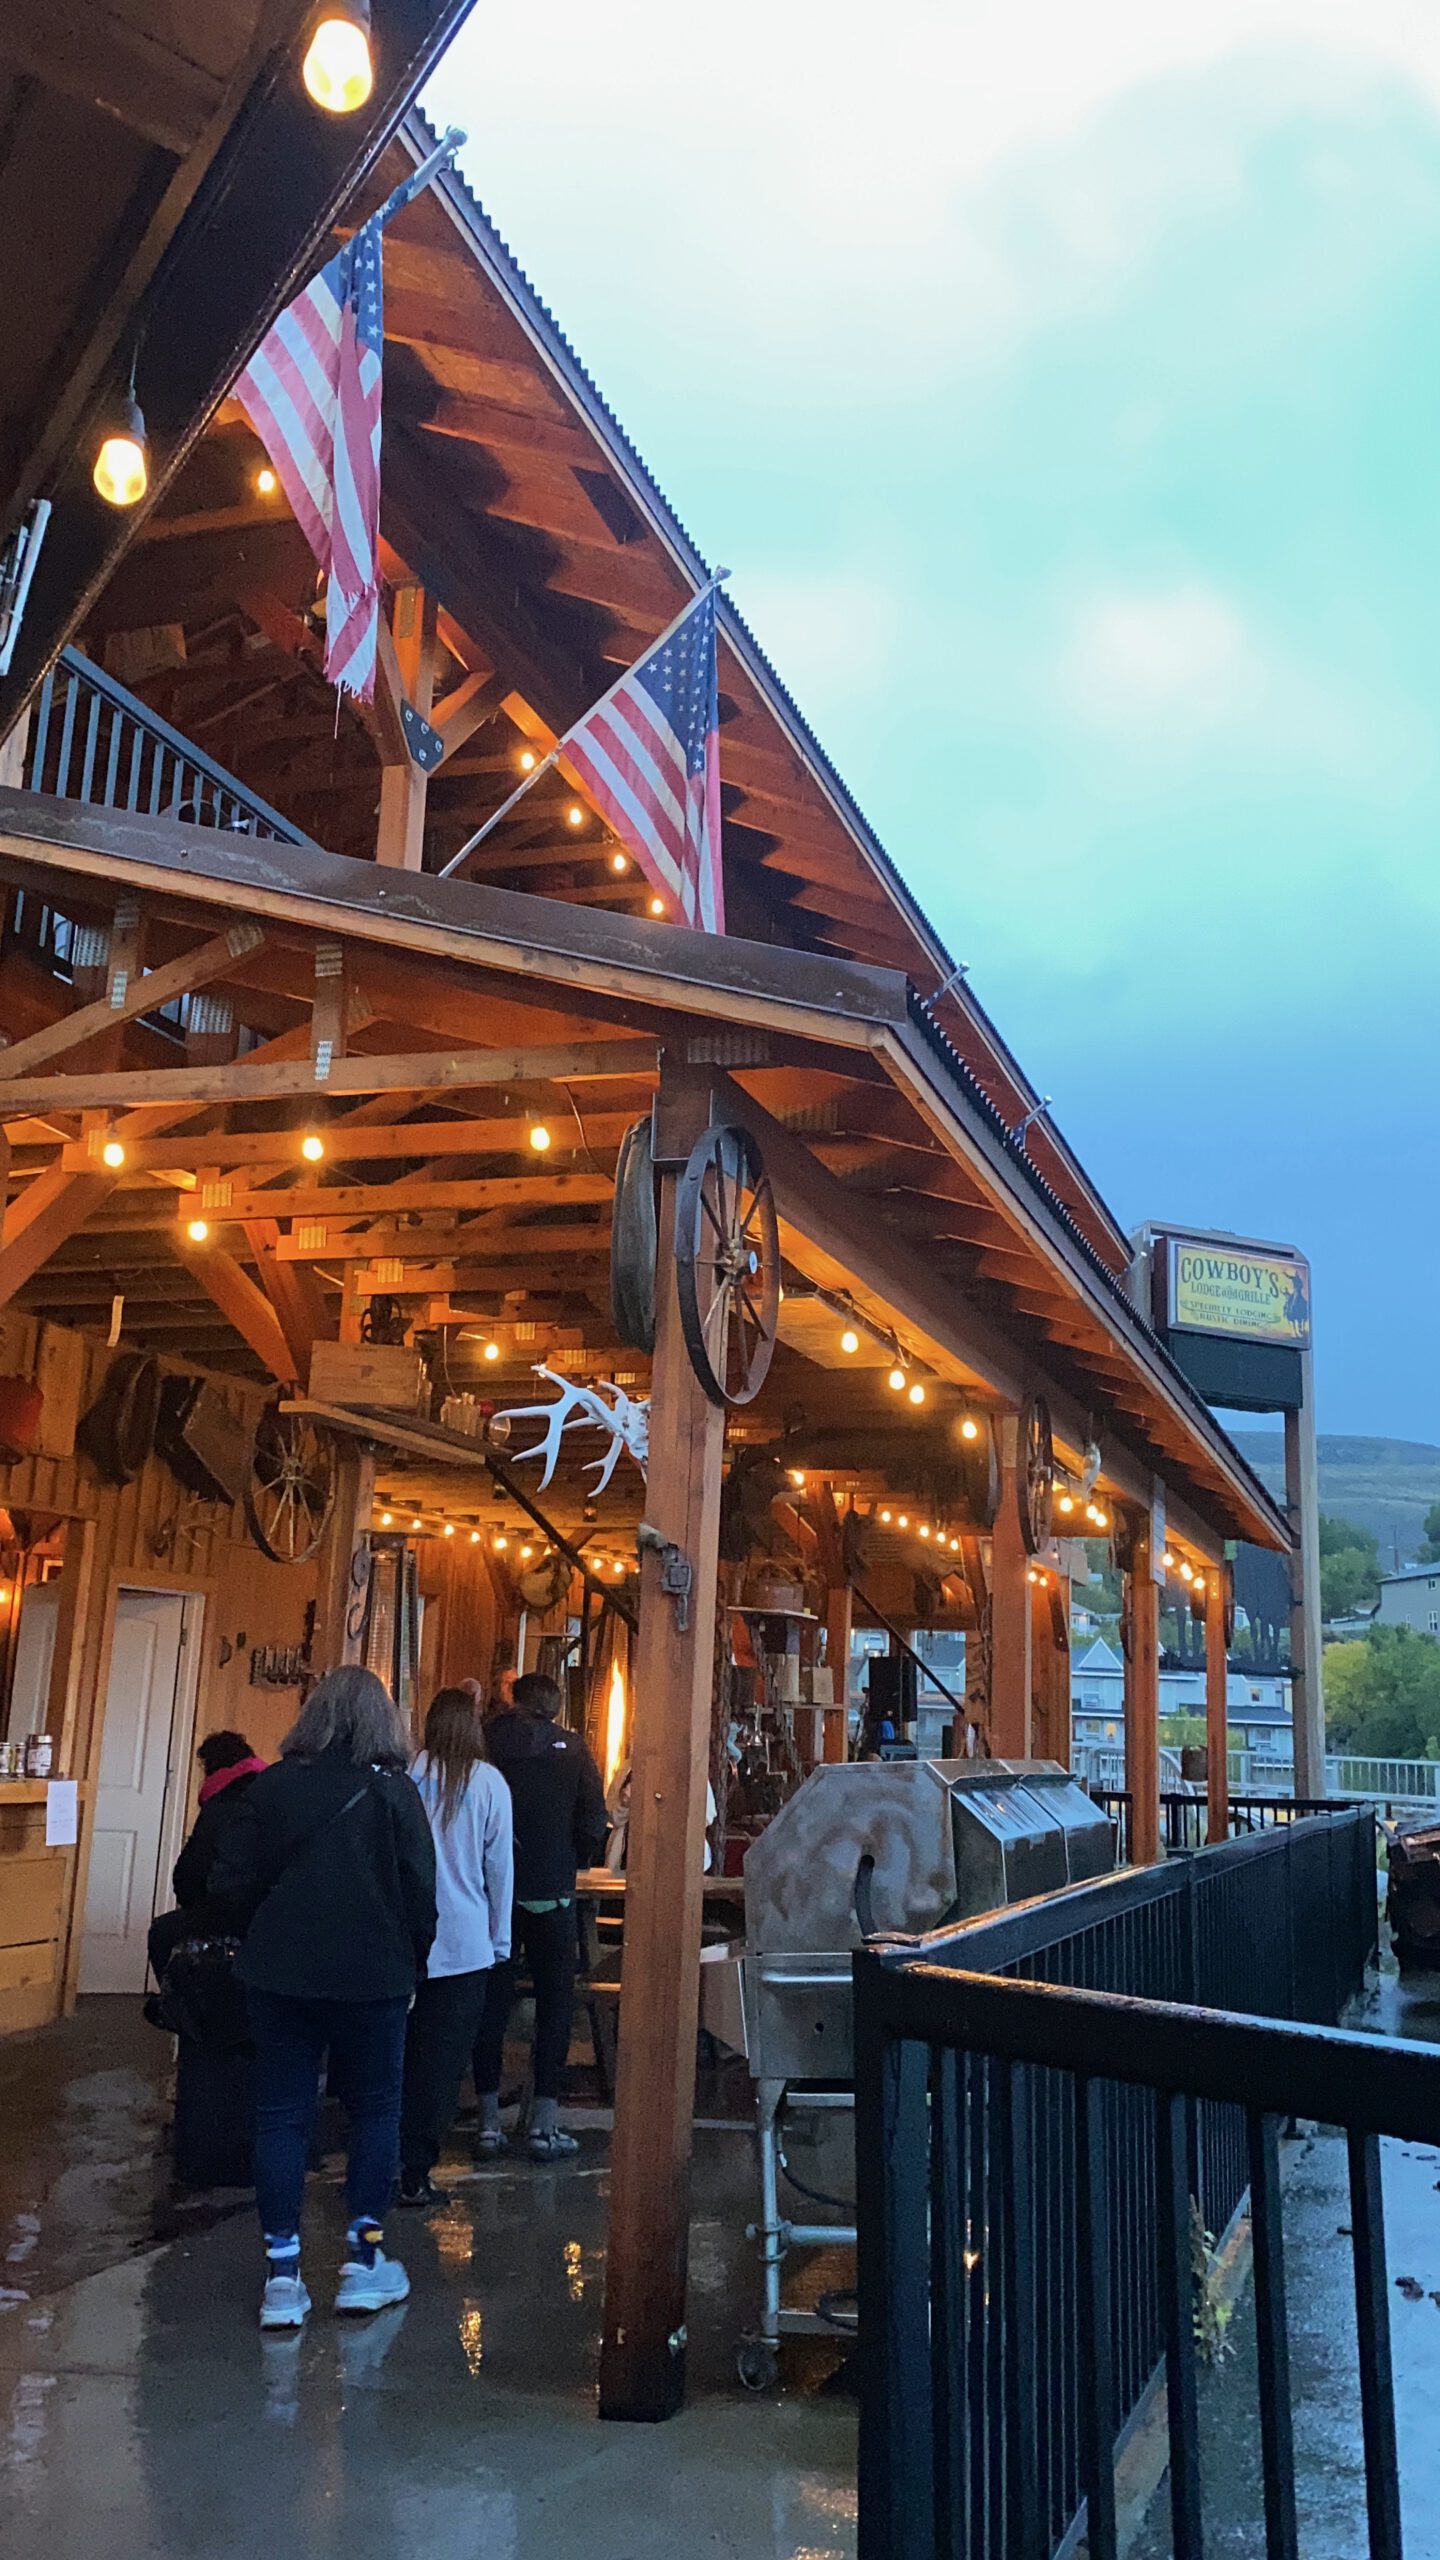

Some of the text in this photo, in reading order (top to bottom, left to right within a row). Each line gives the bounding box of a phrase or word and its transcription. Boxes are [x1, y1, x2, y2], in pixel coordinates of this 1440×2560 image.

[1181, 1257, 1279, 1298] COWBOY'S
[1191, 1281, 1223, 1297] LODGE
[1238, 1288, 1271, 1305] GRILLE
